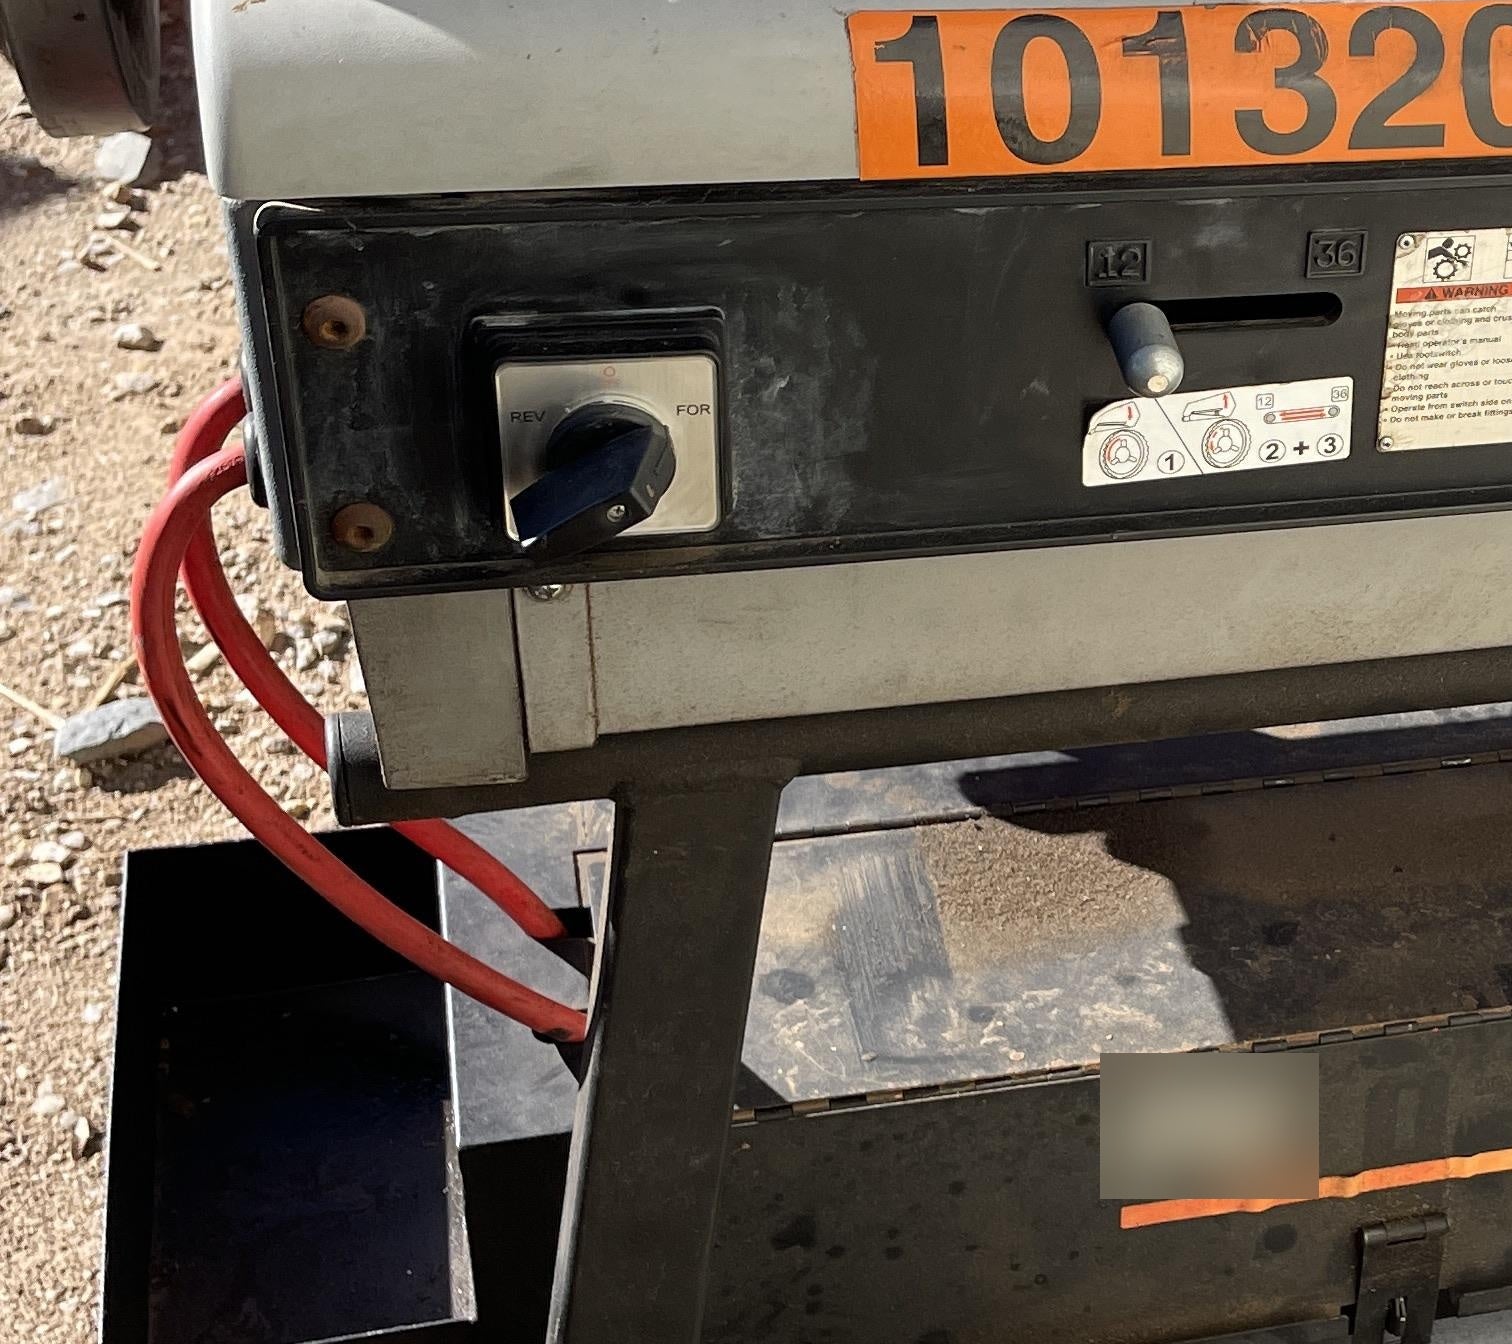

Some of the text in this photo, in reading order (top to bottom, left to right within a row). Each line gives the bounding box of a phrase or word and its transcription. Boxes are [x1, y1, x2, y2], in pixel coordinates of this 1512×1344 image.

[1098, 240, 1357, 278] 12 36
[1442, 285, 1509, 299] WARNING
[1258, 389, 1347, 406] 12 36
[510, 404, 711, 423] REV FOR
[1265, 442, 1280, 461] 2
[1323, 437, 1337, 453] 3
[1164, 454, 1174, 471] 1
